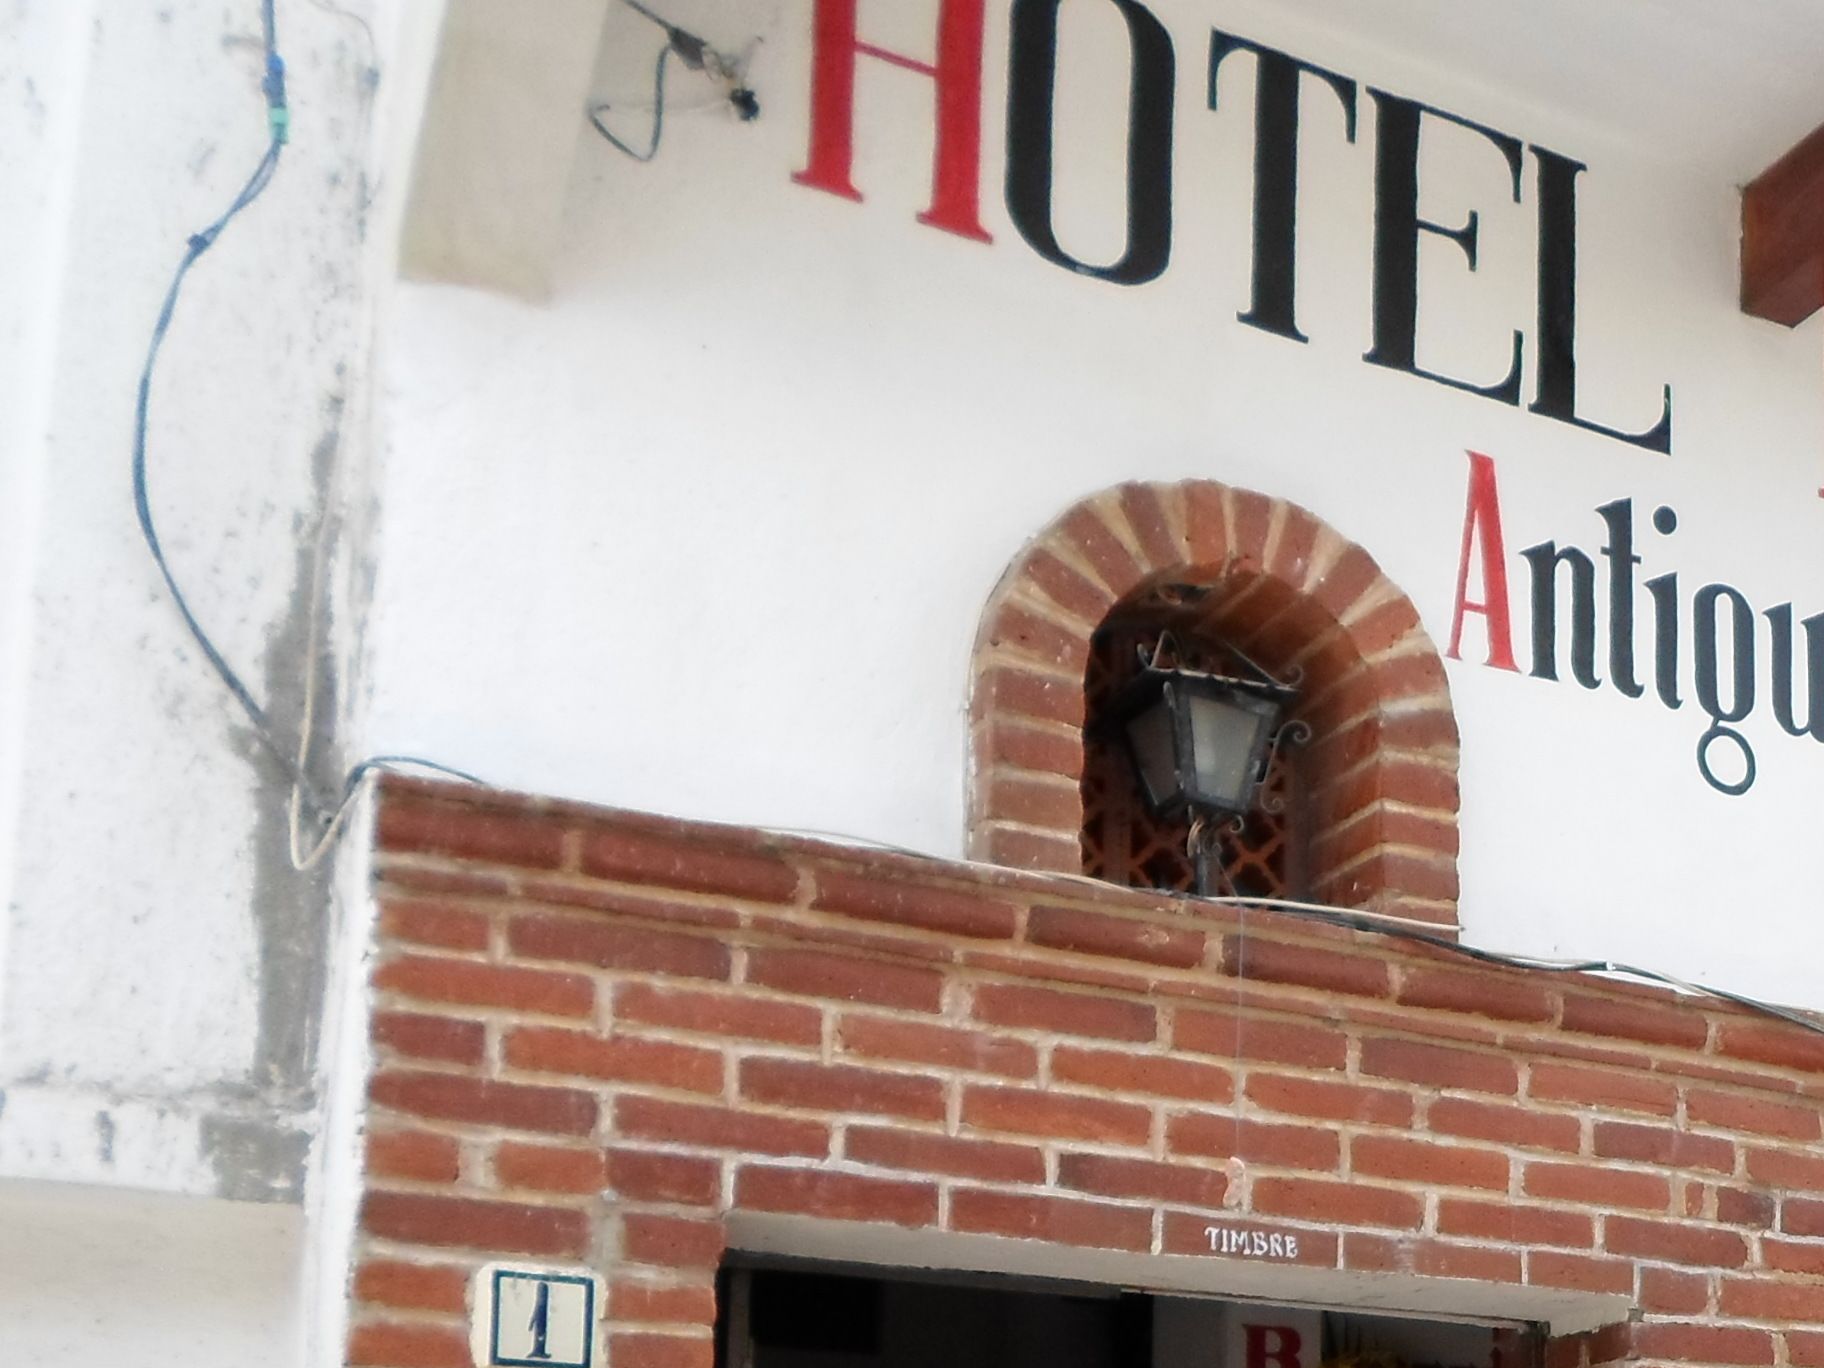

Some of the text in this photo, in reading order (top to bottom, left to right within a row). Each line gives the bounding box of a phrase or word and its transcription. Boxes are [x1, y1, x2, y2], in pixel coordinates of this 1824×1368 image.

[790, 0, 1671, 456] HOTEL
[1204, 1226, 1298, 1259] TIMBRE
[528, 1281, 553, 1359] 1
